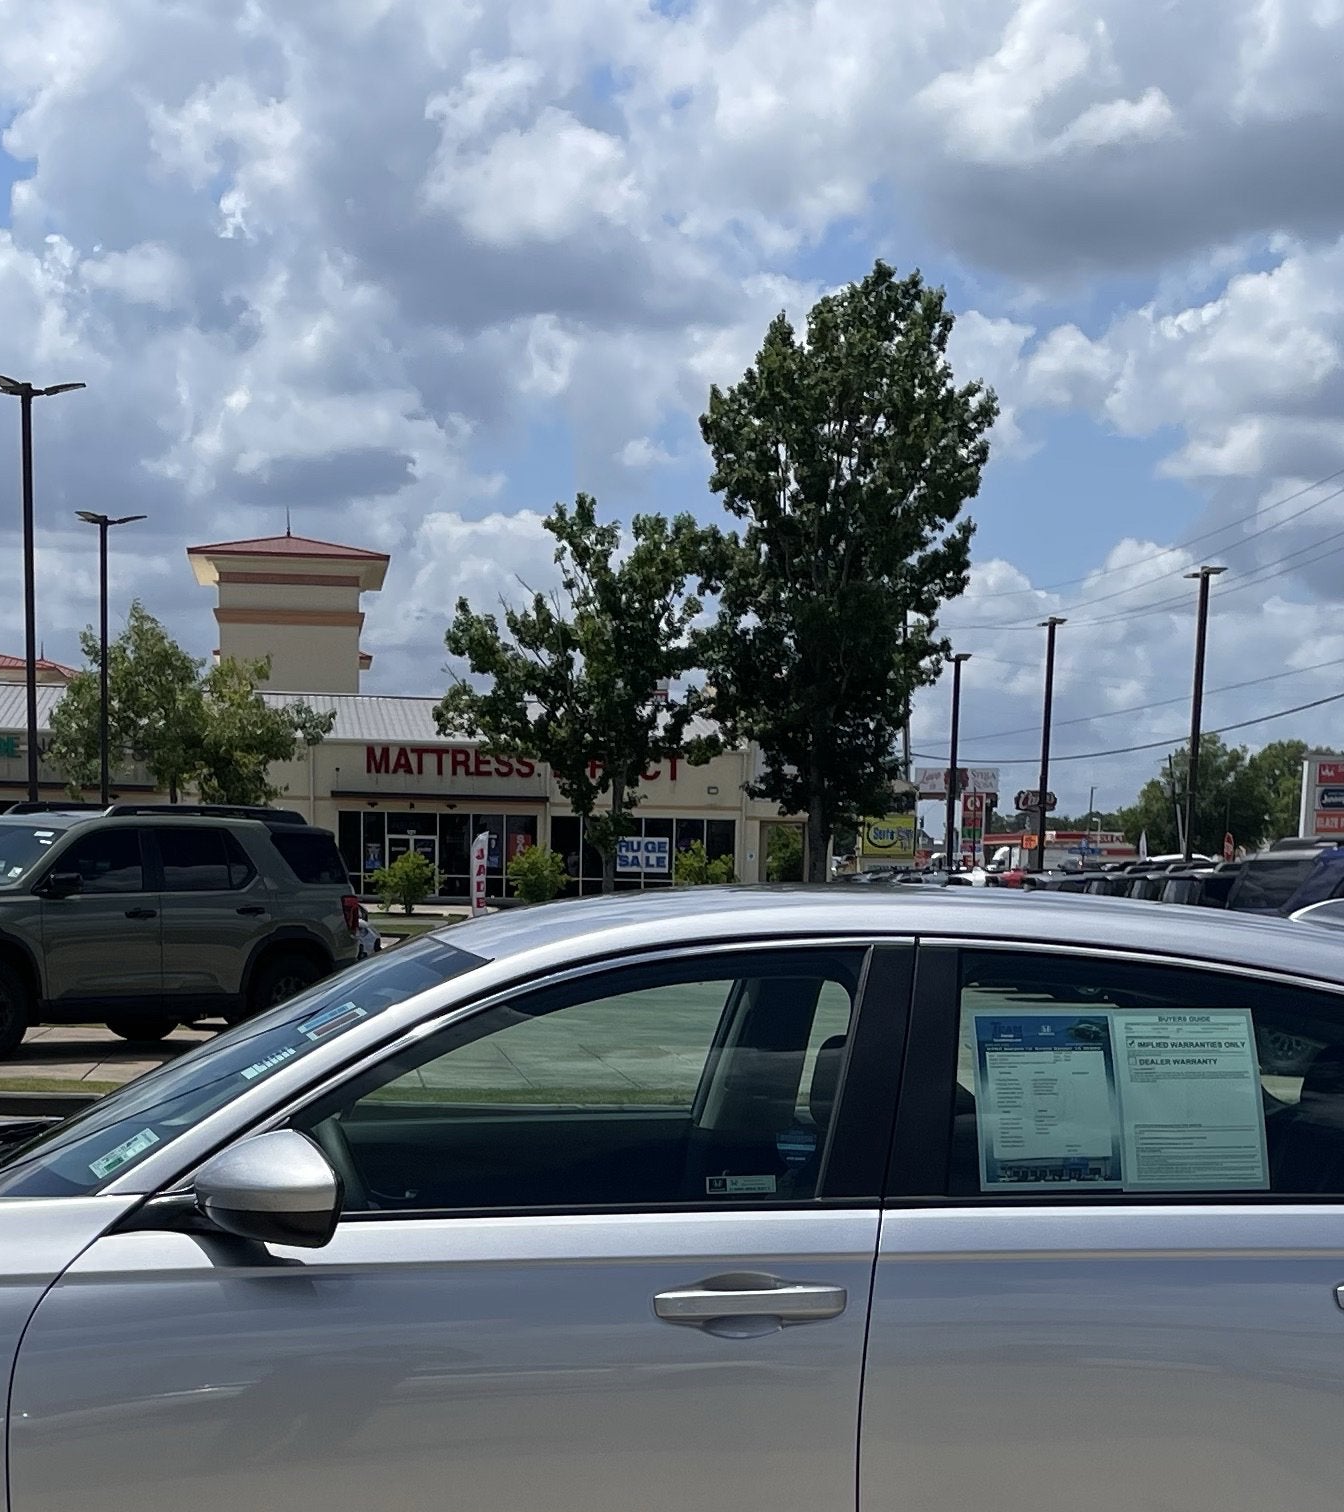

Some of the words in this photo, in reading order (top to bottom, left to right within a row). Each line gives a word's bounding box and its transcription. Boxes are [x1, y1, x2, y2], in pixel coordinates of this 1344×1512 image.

[365, 745, 535, 778] MATTRESS
[619, 840, 667, 853] HUGE
[619, 855, 666, 868] SALE
[1138, 1058, 1171, 1066] DEALER
[1172, 1058, 1218, 1066] WARRANTY
